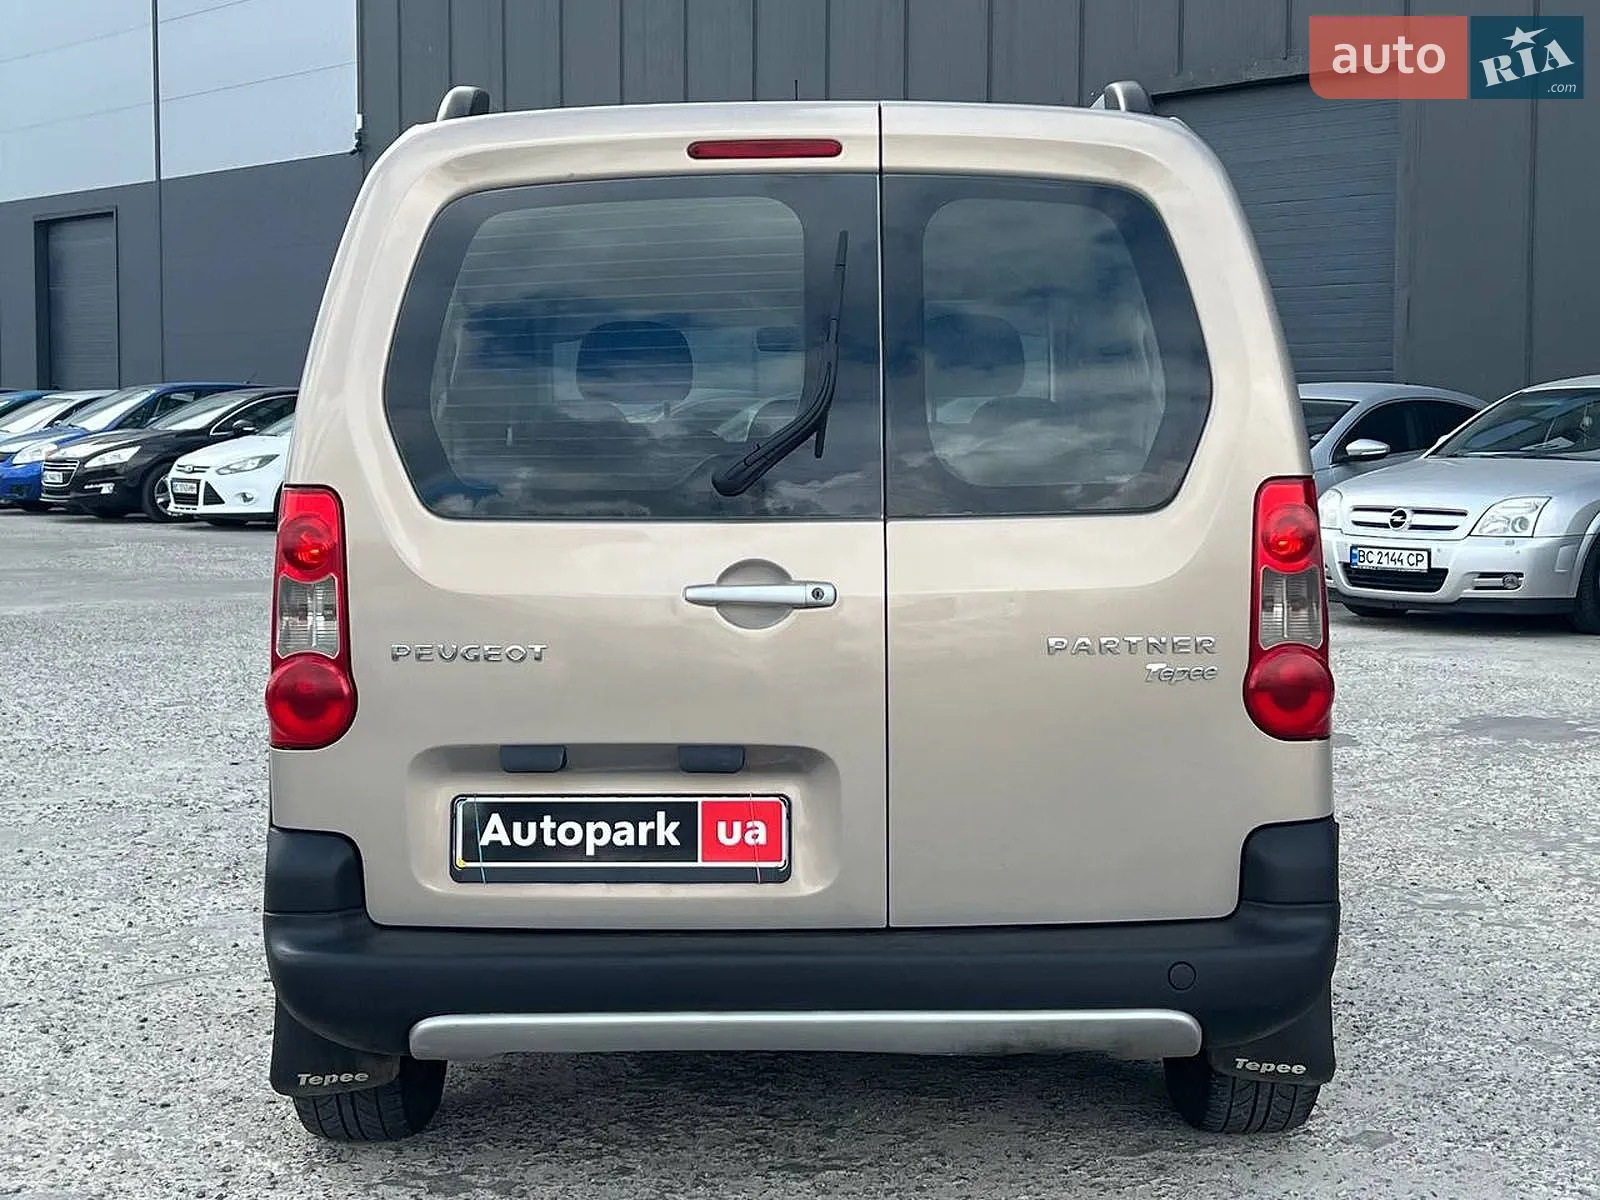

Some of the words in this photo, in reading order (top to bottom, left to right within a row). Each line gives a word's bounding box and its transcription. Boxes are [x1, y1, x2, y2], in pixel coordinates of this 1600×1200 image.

[1358, 549, 1374, 564] BC
[1377, 550, 1404, 566] 2144
[1406, 552, 1425, 567] CP
[391, 643, 548, 662] PEUGEOT
[1047, 635, 1217, 655] PARTNER
[1144, 662, 1219, 685] Tepee
[479, 811, 681, 856] Autopark
[716, 818, 767, 846] ua
[1235, 1057, 1307, 1074] Tepee
[297, 1072, 369, 1087] Tepee
